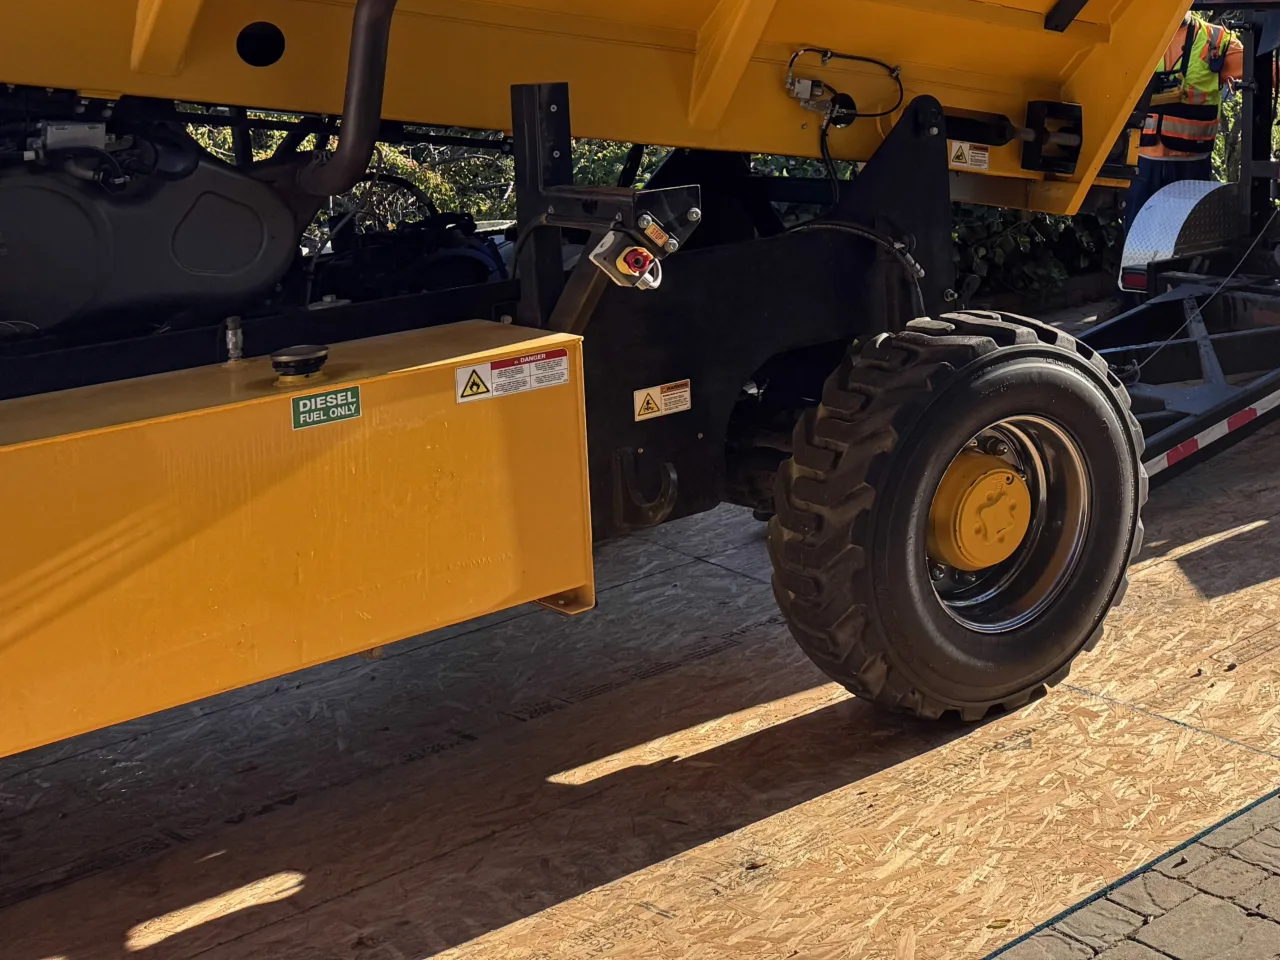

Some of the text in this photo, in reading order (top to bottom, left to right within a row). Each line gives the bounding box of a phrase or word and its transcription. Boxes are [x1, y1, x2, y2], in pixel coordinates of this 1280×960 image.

[649, 227, 664, 242] STOP
[520, 353, 546, 363] DANGER
[299, 391, 357, 412] DIESEL
[300, 404, 357, 424] FUEL ONLY
